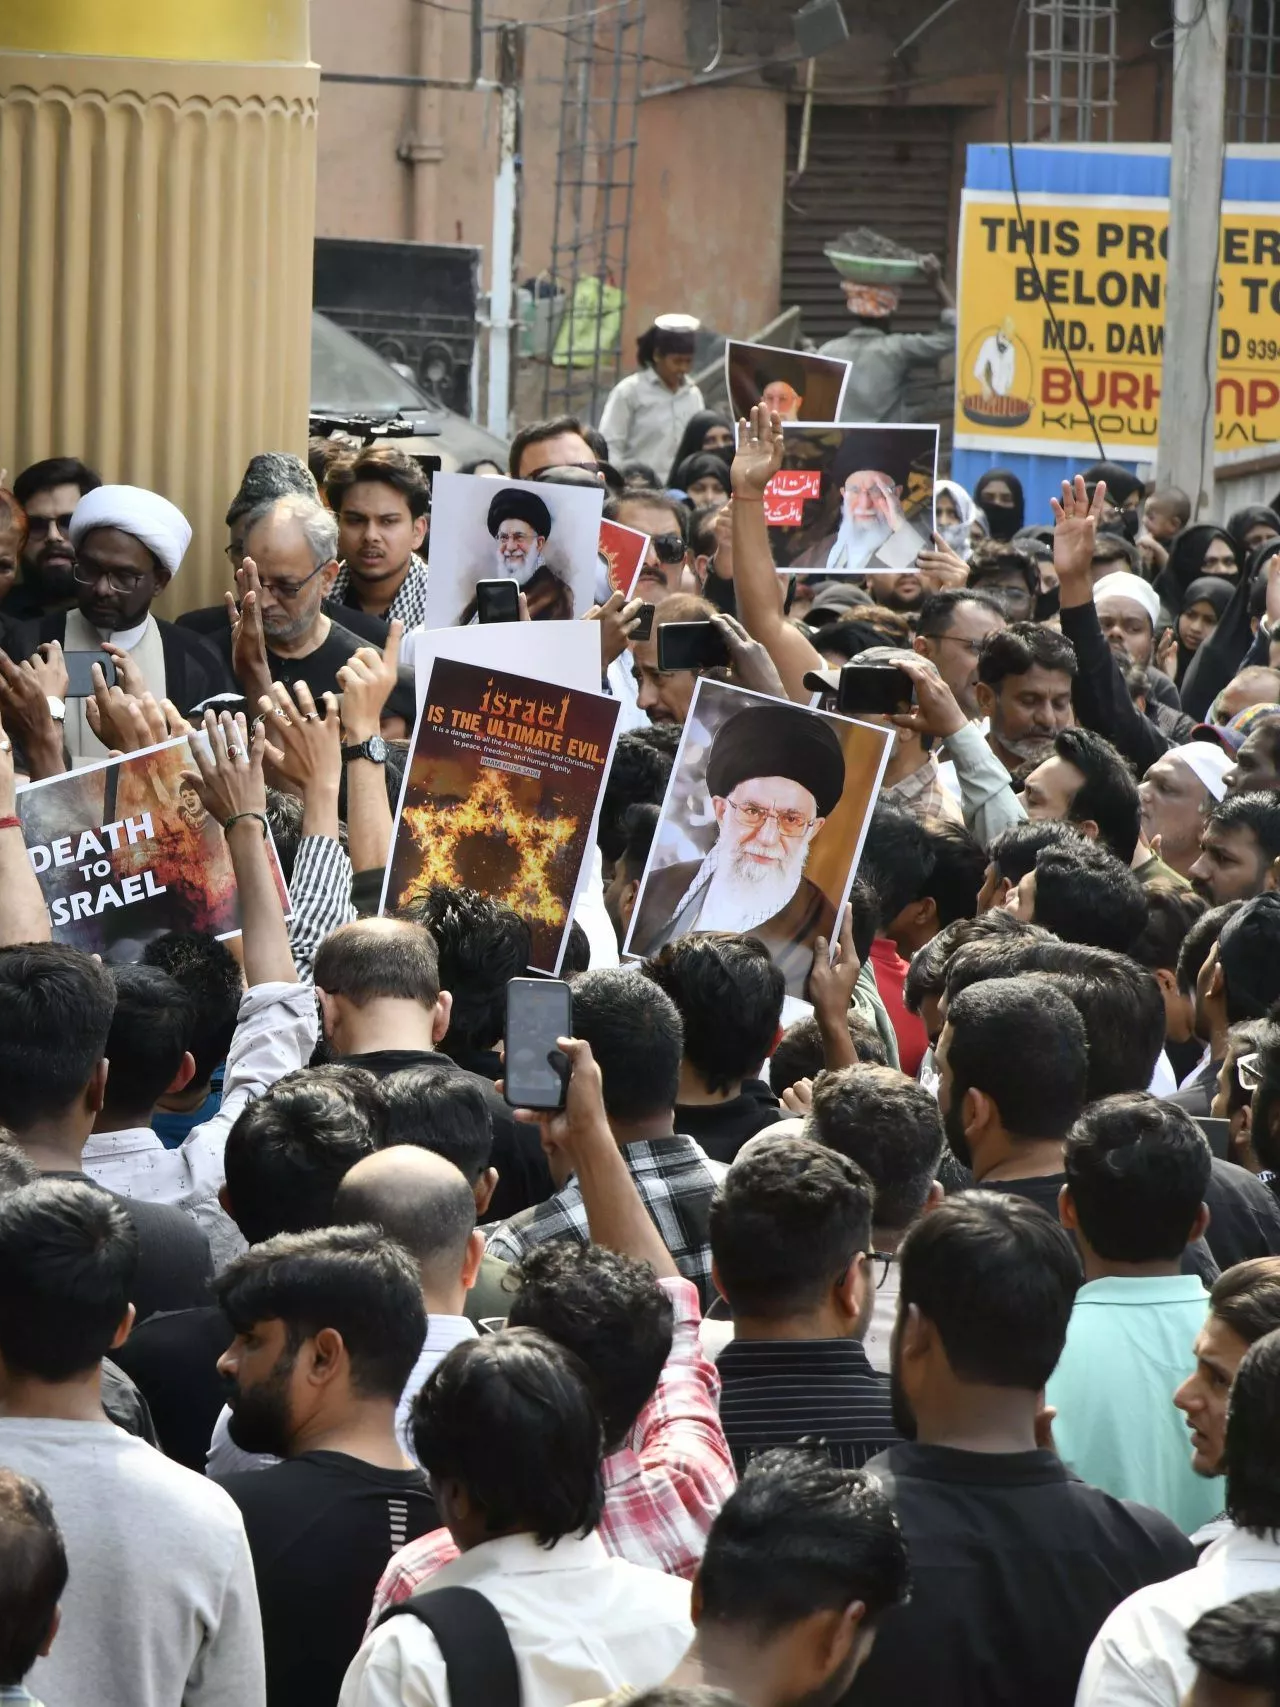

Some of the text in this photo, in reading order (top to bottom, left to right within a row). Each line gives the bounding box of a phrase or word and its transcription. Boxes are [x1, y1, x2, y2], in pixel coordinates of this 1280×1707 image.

[980, 217, 1280, 266] THIS PRER
[1015, 267, 1224, 312] BELON
[1043, 319, 1280, 360] MD. DAWD 939
[427, 704, 605, 764] IS THE ULTIMATE EVIL.
[450, 728, 473, 739] danger
[482, 736, 490, 744] all
[491, 738, 502, 746] the
[503, 741, 522, 752] Arabs,
[524, 745, 550, 758] Muslims
[551, 753, 563, 763] and
[564, 756, 596, 771] Christians,
[460, 741, 482, 752] peace,
[483, 745, 512, 758] freedom,
[513, 753, 526, 761] and
[526, 755, 549, 768] human
[549, 761, 572, 775] dignity.
[482, 758, 502, 768] IMAM
[502, 762, 522, 772] MUSA
[27, 811, 155, 874] DEATH
[79, 860, 111, 882] TO
